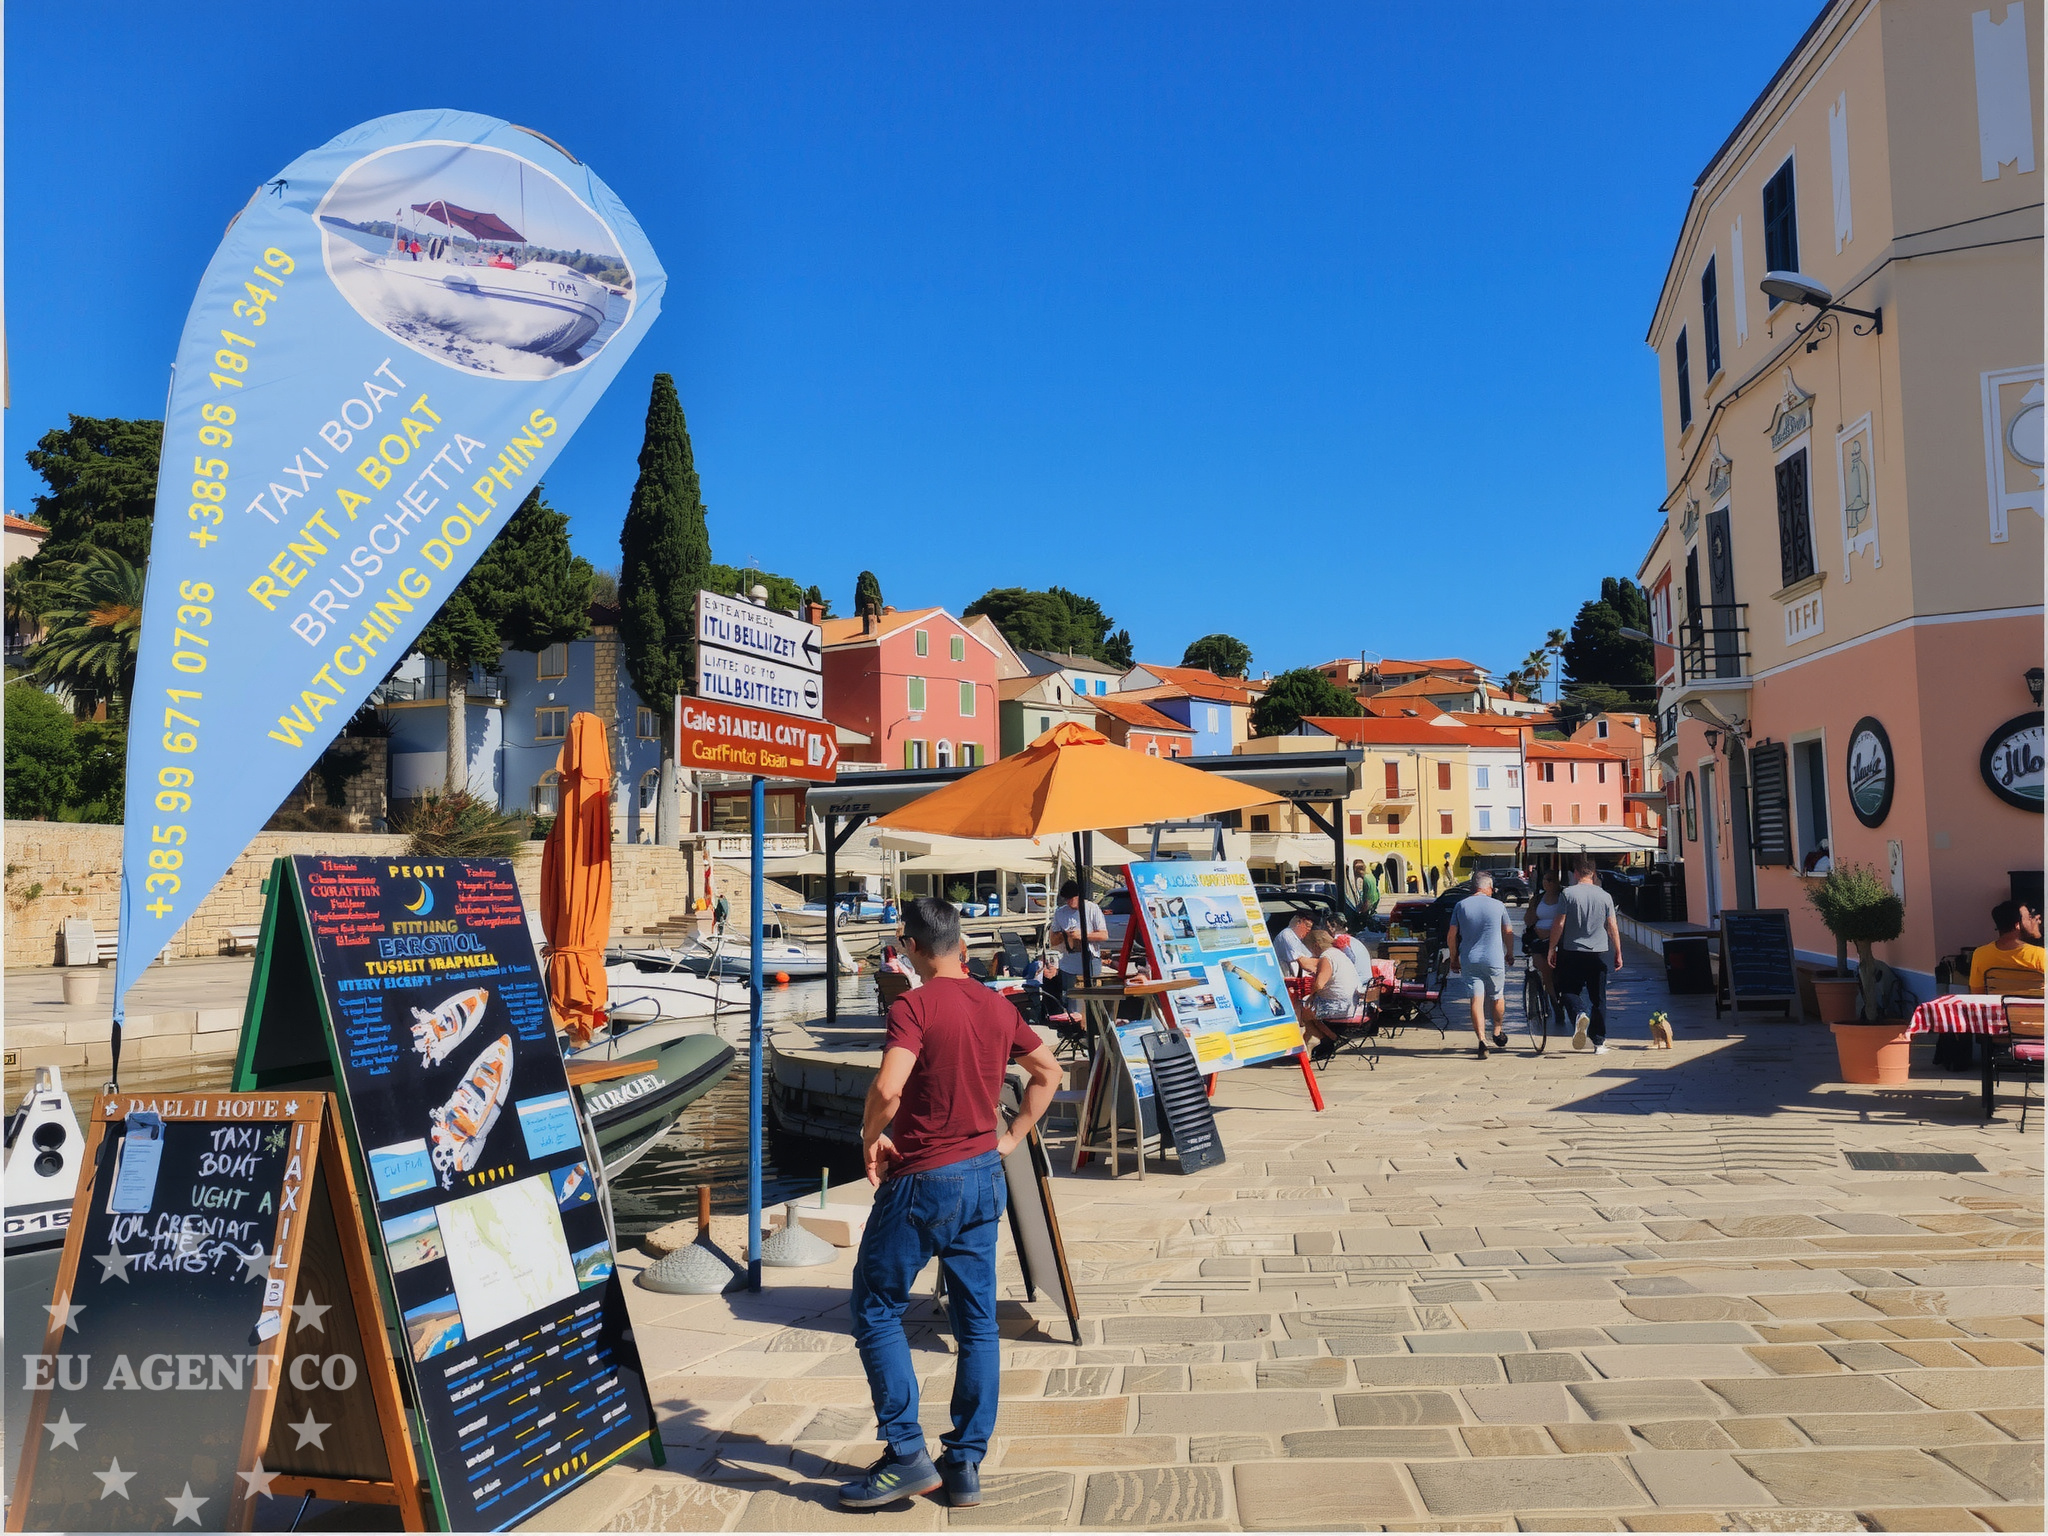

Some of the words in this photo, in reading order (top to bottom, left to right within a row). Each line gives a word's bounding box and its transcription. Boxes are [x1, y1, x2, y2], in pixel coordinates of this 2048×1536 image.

[245, 446, 330, 525] TAXI
[318, 357, 407, 454] BOAT
[188, 456, 229, 548] +385
[247, 507, 342, 611] RENT
[336, 486, 372, 522] A
[356, 393, 444, 491] BOAT
[289, 432, 486, 647] BRUSCHETTA
[268, 567, 432, 748] WATCHING
[421, 408, 558, 568] DOLPHINS
[162, 689, 203, 754] 671
[155, 766, 195, 813] 99
[145, 825, 187, 919] +385
[210, 1126, 261, 1152] TAXI
